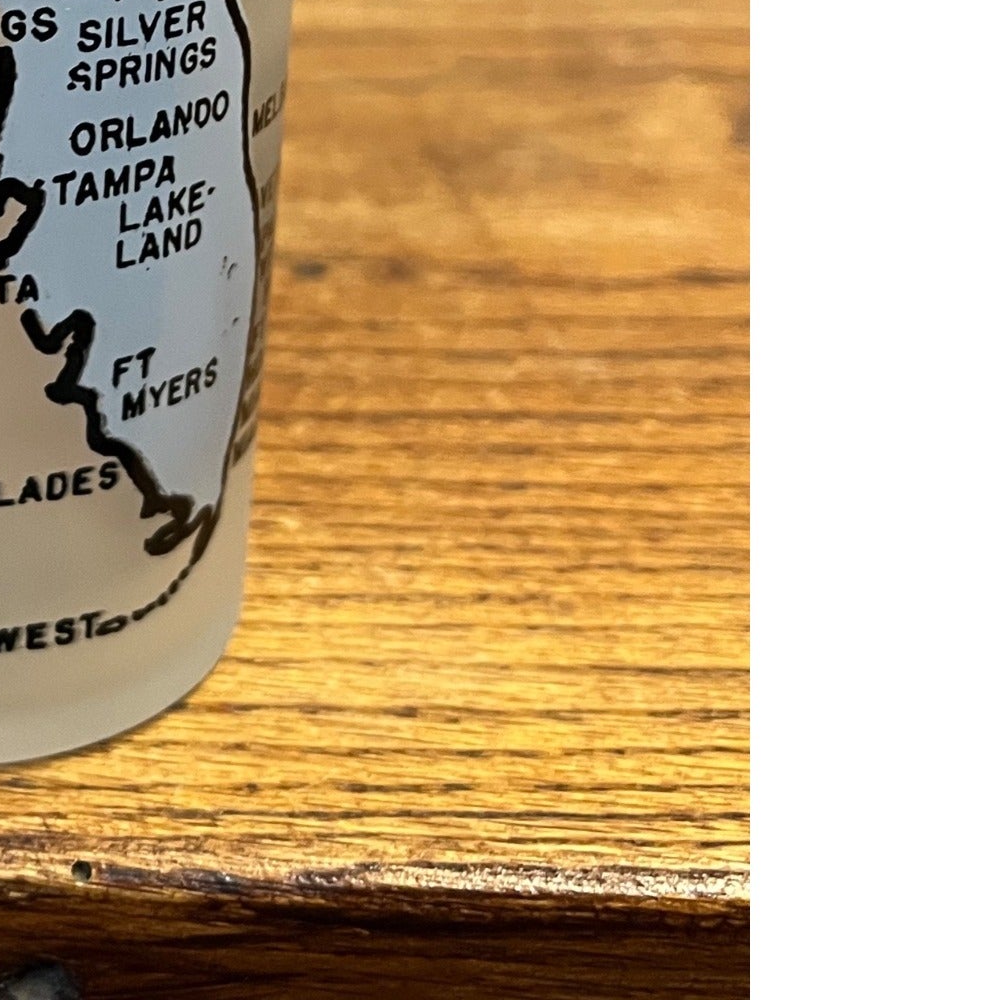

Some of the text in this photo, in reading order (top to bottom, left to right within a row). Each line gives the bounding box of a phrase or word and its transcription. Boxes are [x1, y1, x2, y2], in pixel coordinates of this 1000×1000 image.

[77, 0, 207, 53] SILVER
[68, 36, 217, 92] SPRINGS
[69, 90, 230, 157] ORLANDO
[53, 155, 176, 207] TAMPA
[116, 217, 203, 270] LAND
[112, 347, 156, 389] FT
[121, 356, 219, 421] MYERS
